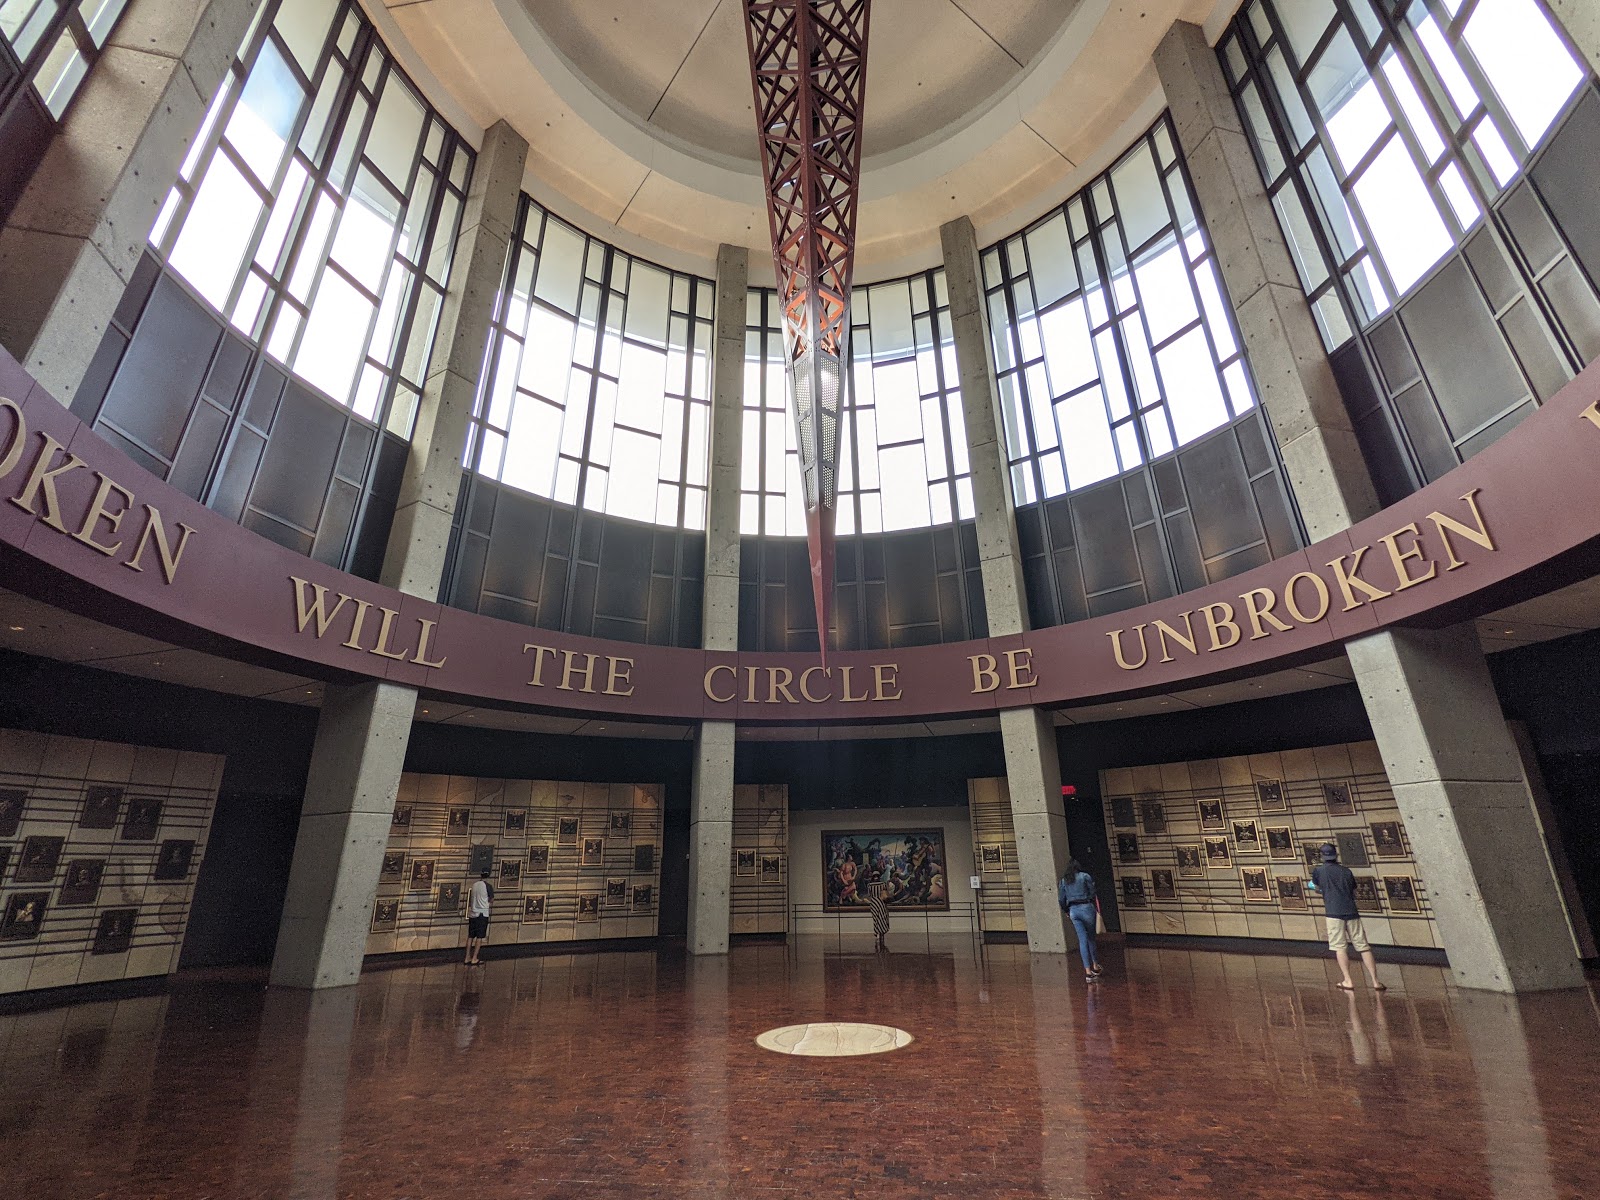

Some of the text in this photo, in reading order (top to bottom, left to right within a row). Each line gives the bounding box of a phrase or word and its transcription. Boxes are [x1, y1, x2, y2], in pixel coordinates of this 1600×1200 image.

[291, 576, 447, 668] WILL
[523, 643, 635, 697] THE
[703, 663, 903, 704] CIRCLE
[966, 647, 1039, 694] BE
[1106, 488, 1497, 671] UNBROKEN
